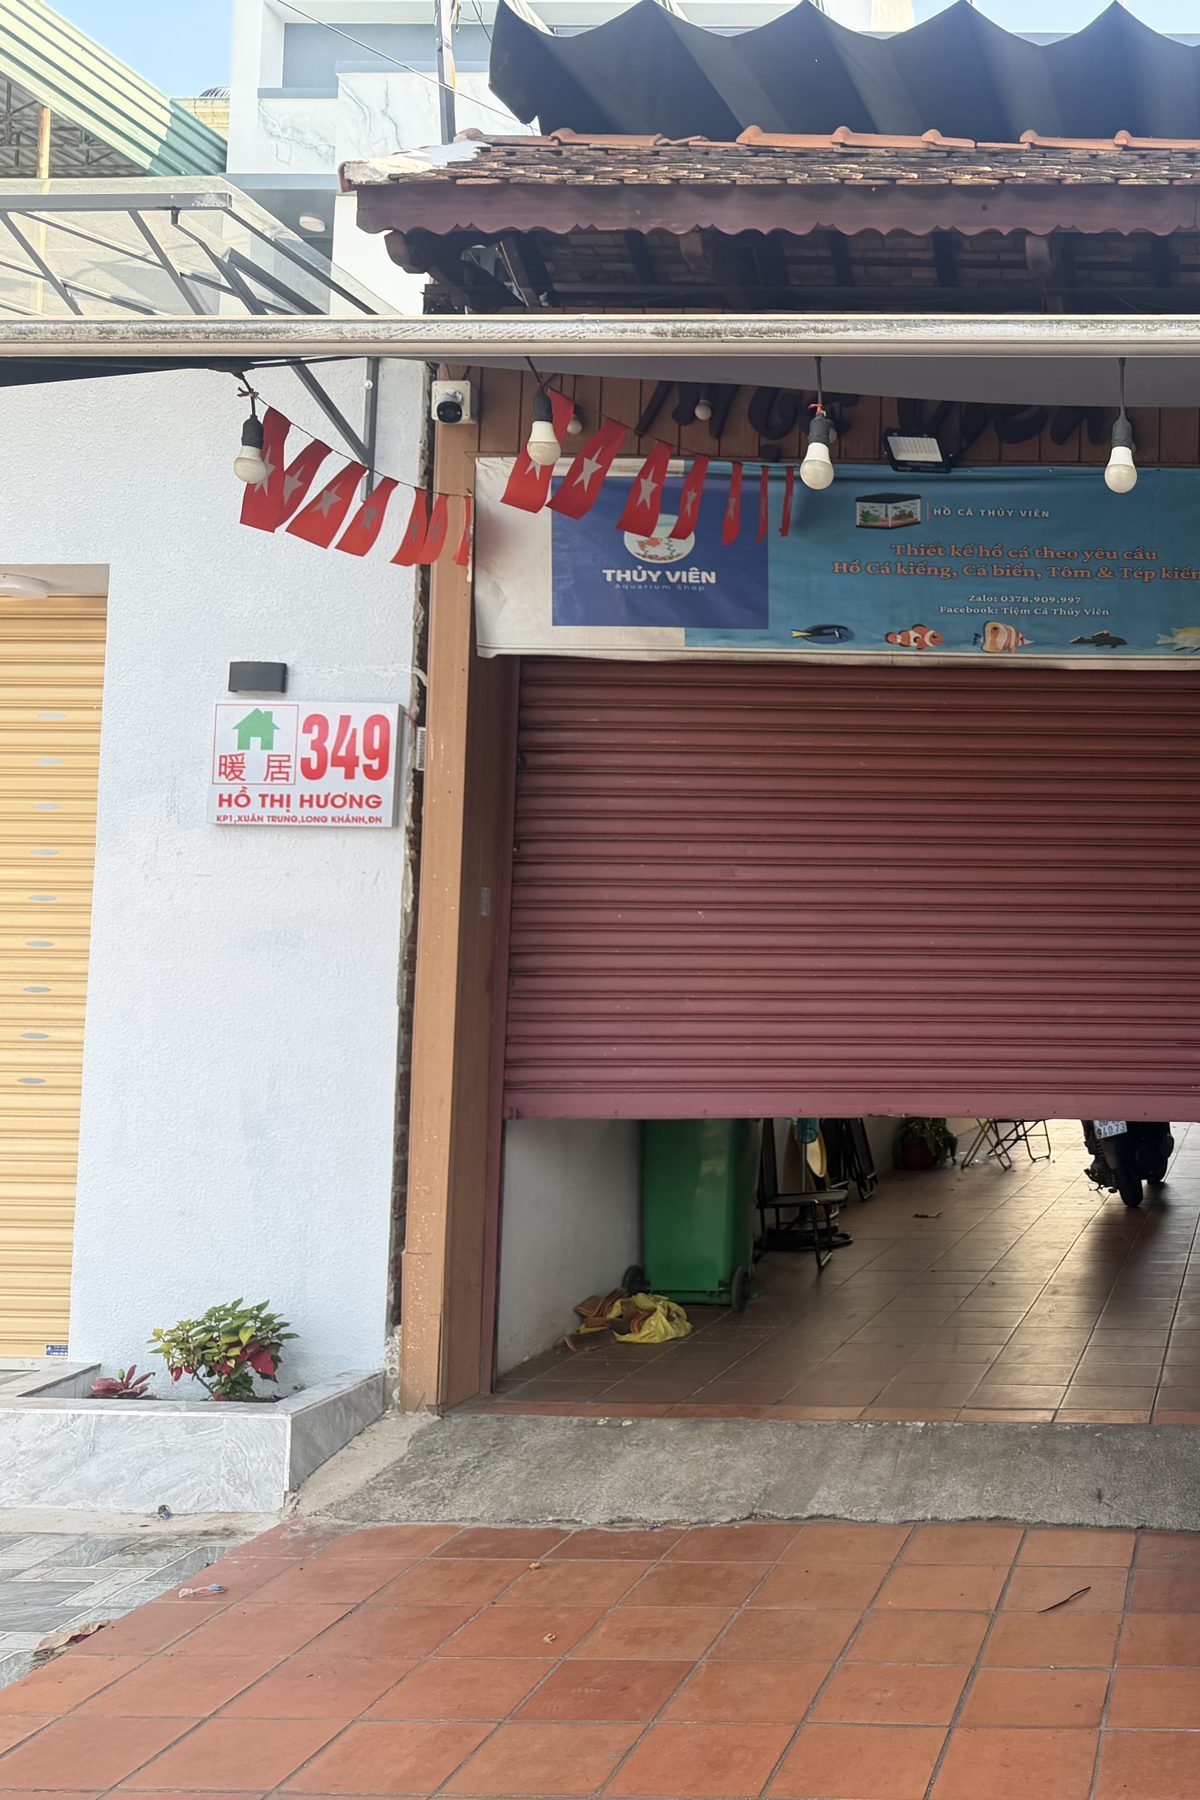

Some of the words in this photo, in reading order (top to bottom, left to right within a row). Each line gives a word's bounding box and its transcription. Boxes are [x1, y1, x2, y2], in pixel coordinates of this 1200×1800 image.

[933, 505, 951, 516] HỒ
[957, 507, 974, 517] CÁ
[980, 507, 1014, 517] THỦY
[1020, 508, 1050, 518] VIÊN
[891, 542, 945, 557] Thiết
[950, 543, 975, 557] kế
[978, 543, 1004, 558] hồ
[1008, 546, 1029, 558] cá
[1034, 546, 1079, 559] theo
[1083, 546, 1118, 562] yêu
[1122, 546, 1158, 560] cầu
[602, 565, 662, 582] THỦY
[665, 567, 717, 584] VIÊN
[833, 560, 861, 575] Hồ
[866, 561, 892, 575] Cá
[962, 563, 988, 577] Cá
[1047, 565, 1092, 579] Tôm
[1097, 566, 1115, 579] &
[1118, 566, 1156, 583] Tép
[614, 583, 671, 591] Aquarium
[968, 595, 998, 603] Zalo:
[939, 605, 998, 615] Facebook:
[1001, 606, 1030, 617] Tiệm
[1033, 607, 1048, 615] Cá
[1083, 608, 1110, 616] Viên
[300, 713, 391, 781] 349
[218, 786, 251, 808] HỒ
[258, 793, 291, 812] THỊ
[300, 791, 383, 809] HƯƠNG
